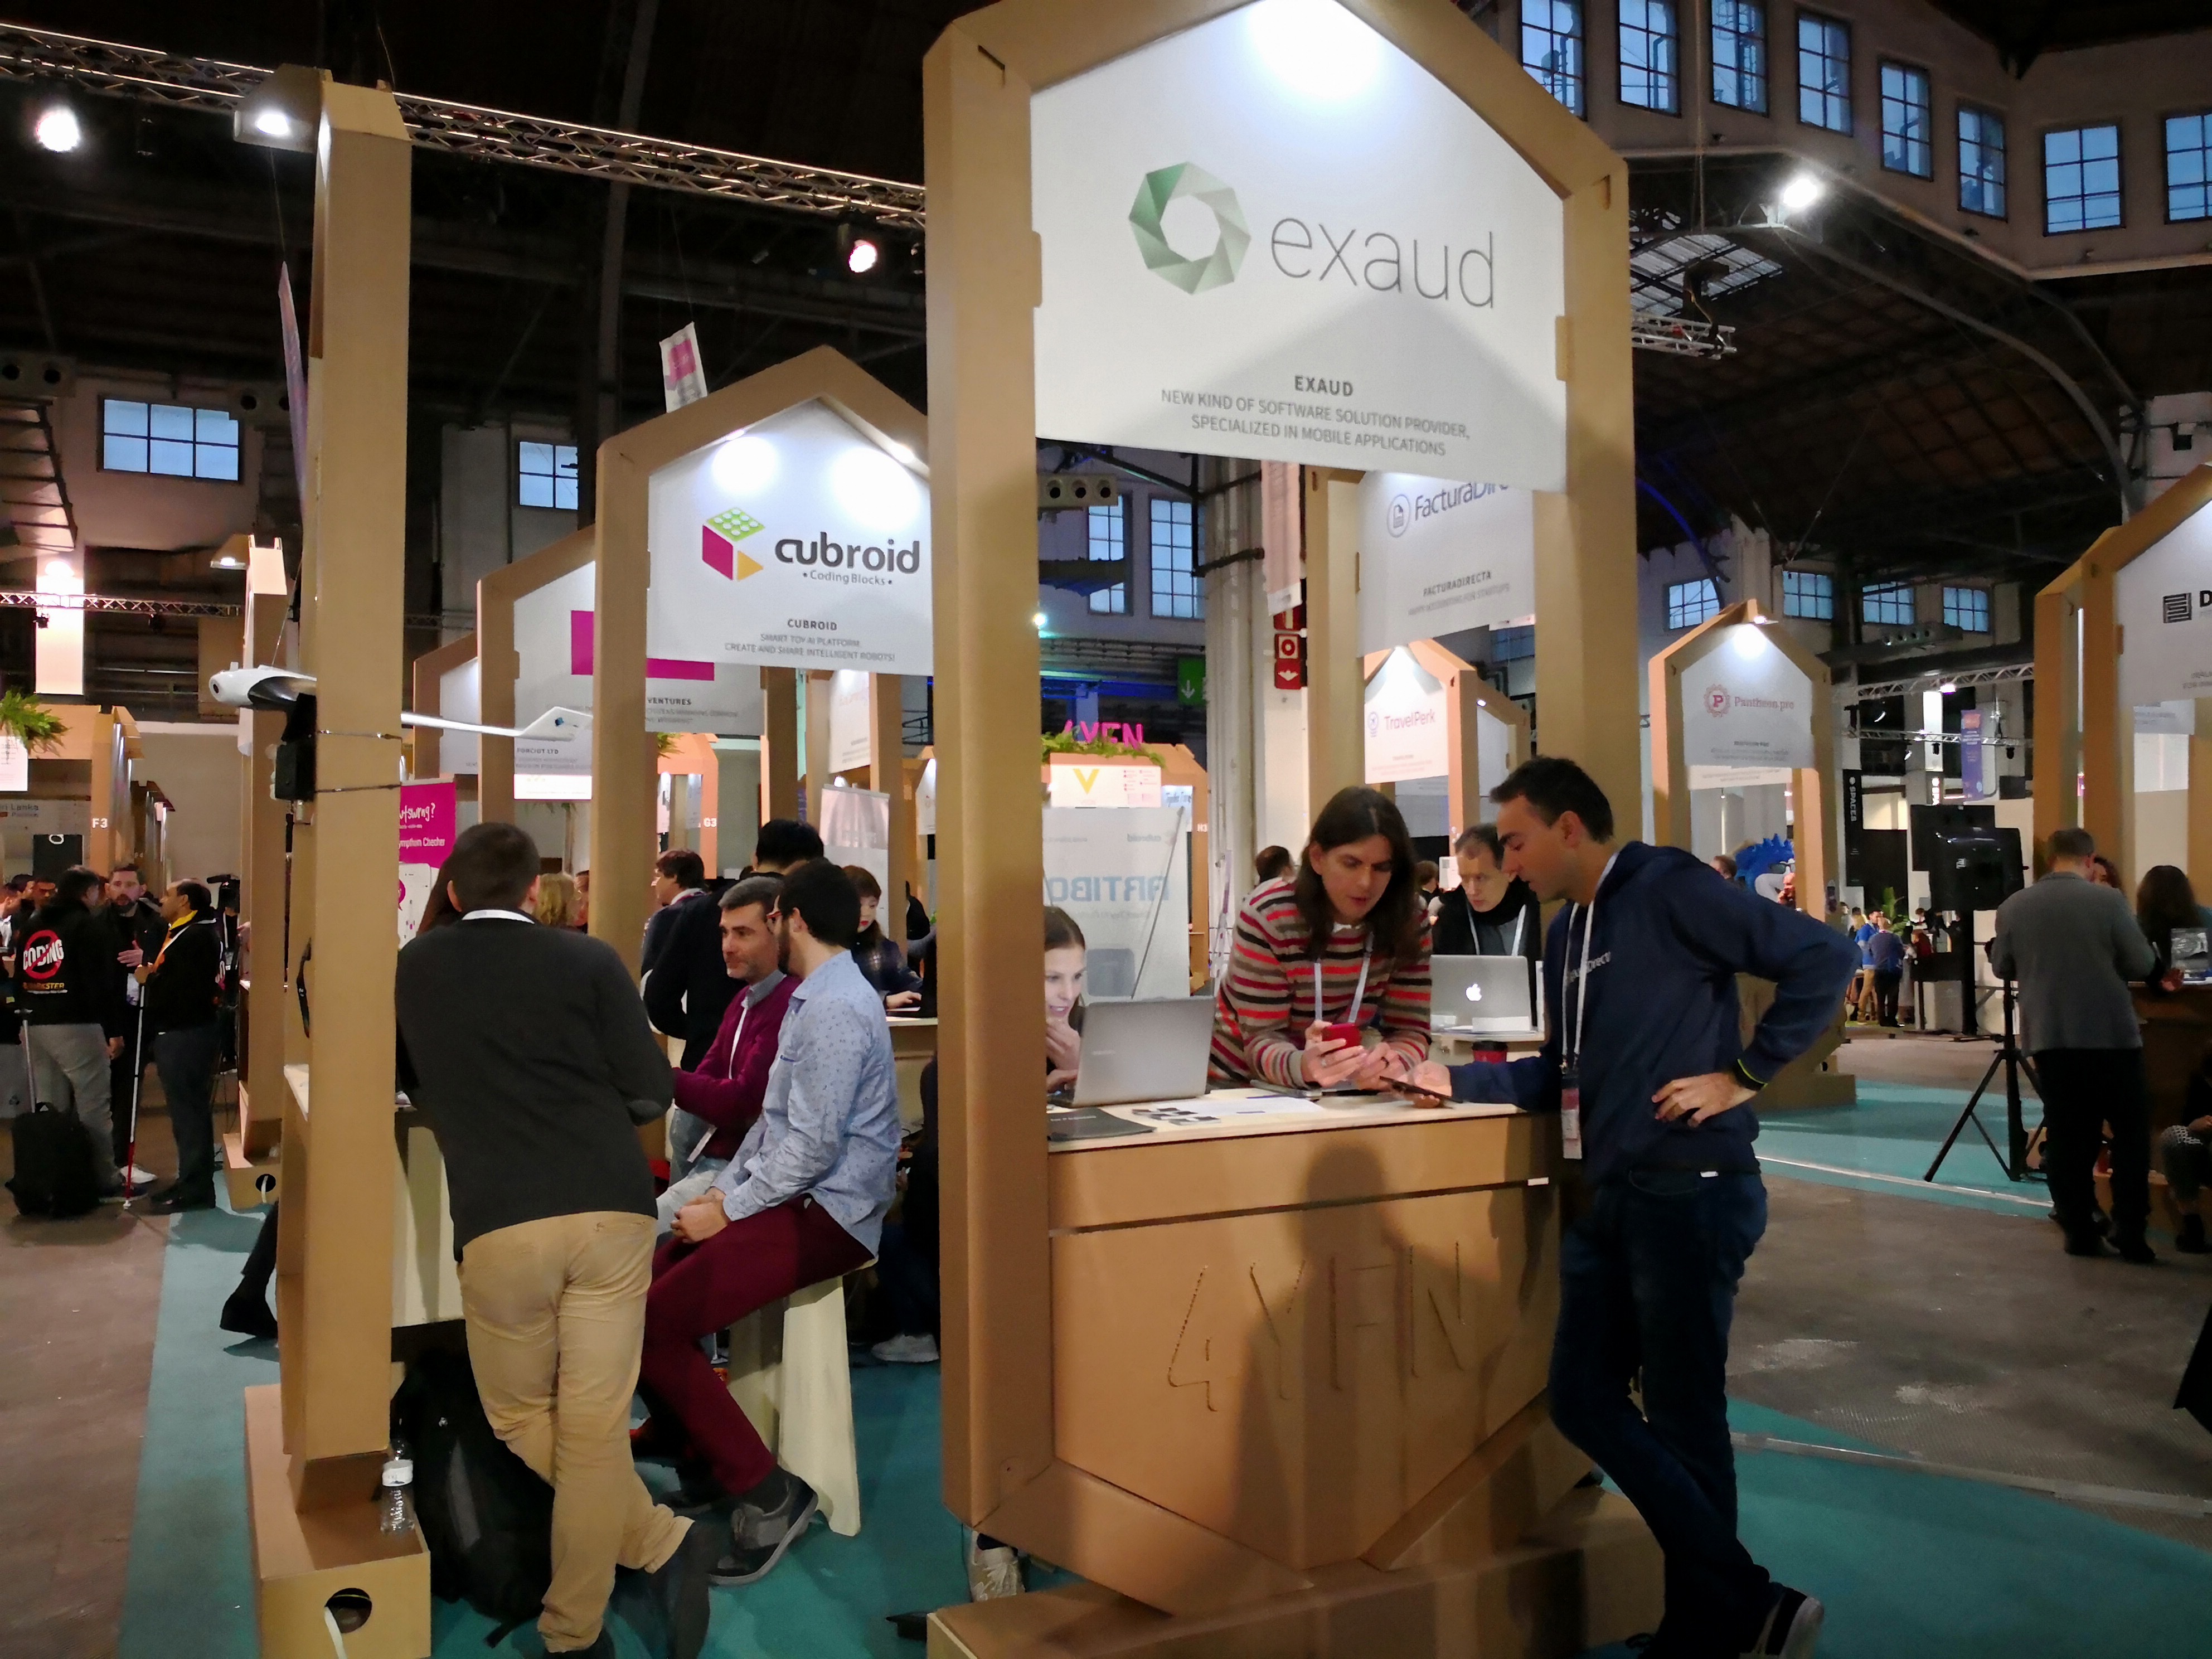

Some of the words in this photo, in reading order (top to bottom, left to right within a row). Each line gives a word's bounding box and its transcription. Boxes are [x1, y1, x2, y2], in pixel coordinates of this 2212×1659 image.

[1271, 217, 1493, 309] exaud
[1294, 375, 1354, 397] EXAUD
[1161, 389, 1194, 405] NEW
[1197, 393, 1233, 410] KIND
[1236, 397, 1255, 411] OF
[1258, 400, 1332, 421] SOFTWARE
[1336, 408, 1401, 429] SOLUTION
[1405, 416, 1471, 440] PROVIDER,
[1191, 414, 1280, 438] SPECIALIZED
[1284, 425, 1298, 439] IN
[1301, 426, 1352, 446] MOBILE
[1354, 433, 1447, 456] APPLICATIONS
[774, 531, 920, 574] cubroid
[810, 570, 850, 585] Coding
[851, 574, 886, 586] Blocks
[1423, 570, 1492, 597] FACTURADIRECTA
[787, 618, 838, 631] CUBROID
[760, 633, 788, 642] SMART
[817, 637, 860, 647] PLATFORM
[724, 643, 757, 653] CREATE
[758, 645, 776, 654] AND
[778, 646, 804, 656] SHARE
[806, 648, 858, 660] INTELLIGENT
[1734, 696, 1794, 711] Pantheon.pro
[1384, 709, 1436, 730] TravelPerk
[92, 818, 108, 828] F3
[23, 939, 64, 970] CODING
